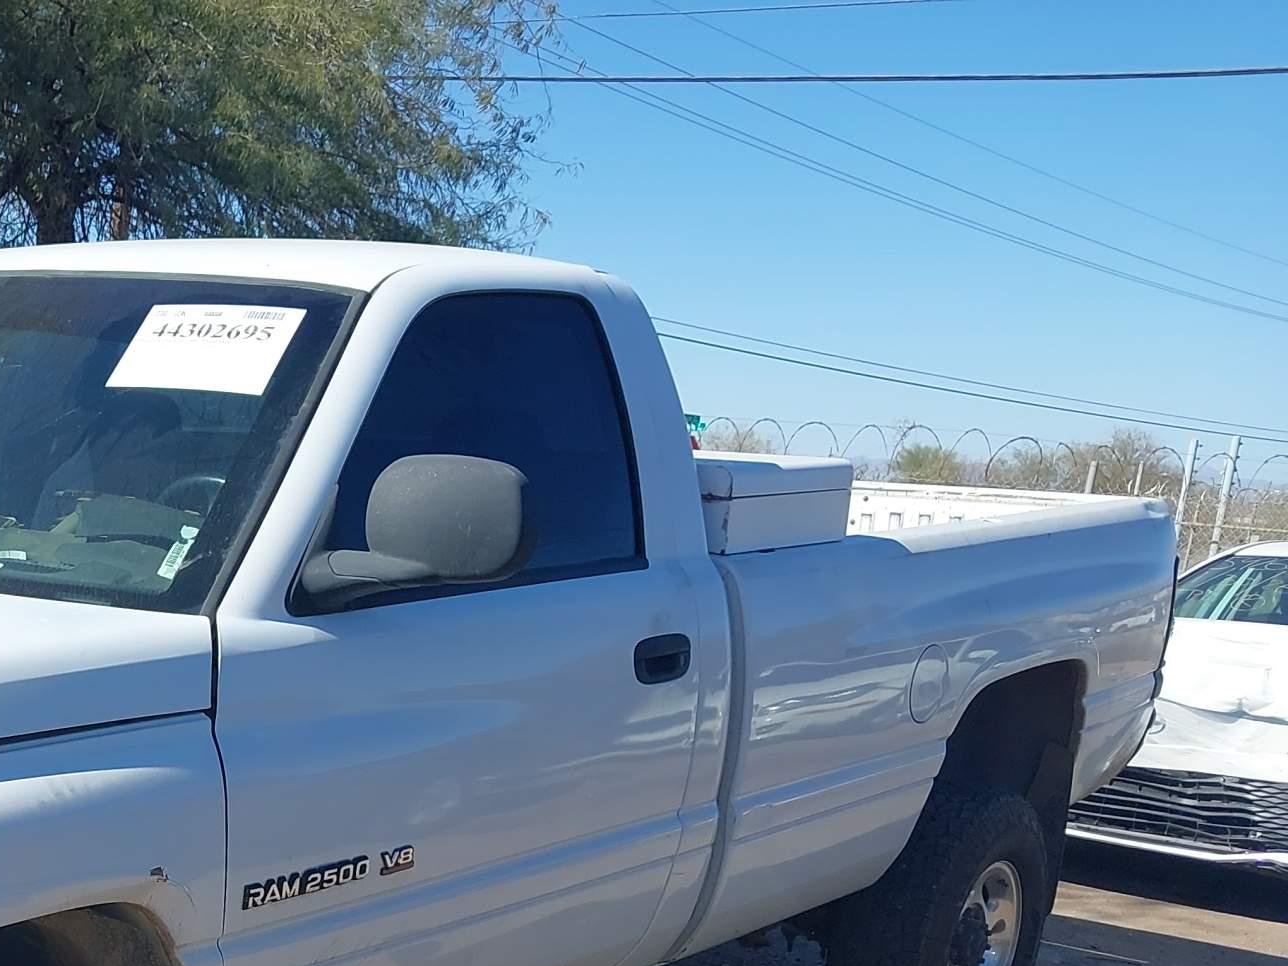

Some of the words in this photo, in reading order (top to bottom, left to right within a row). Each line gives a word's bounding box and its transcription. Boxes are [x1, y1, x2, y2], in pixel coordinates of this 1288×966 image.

[151, 322, 276, 342] 44302695
[244, 873, 302, 909] RAM
[303, 856, 370, 893] 2500
[381, 845, 414, 870] V8
